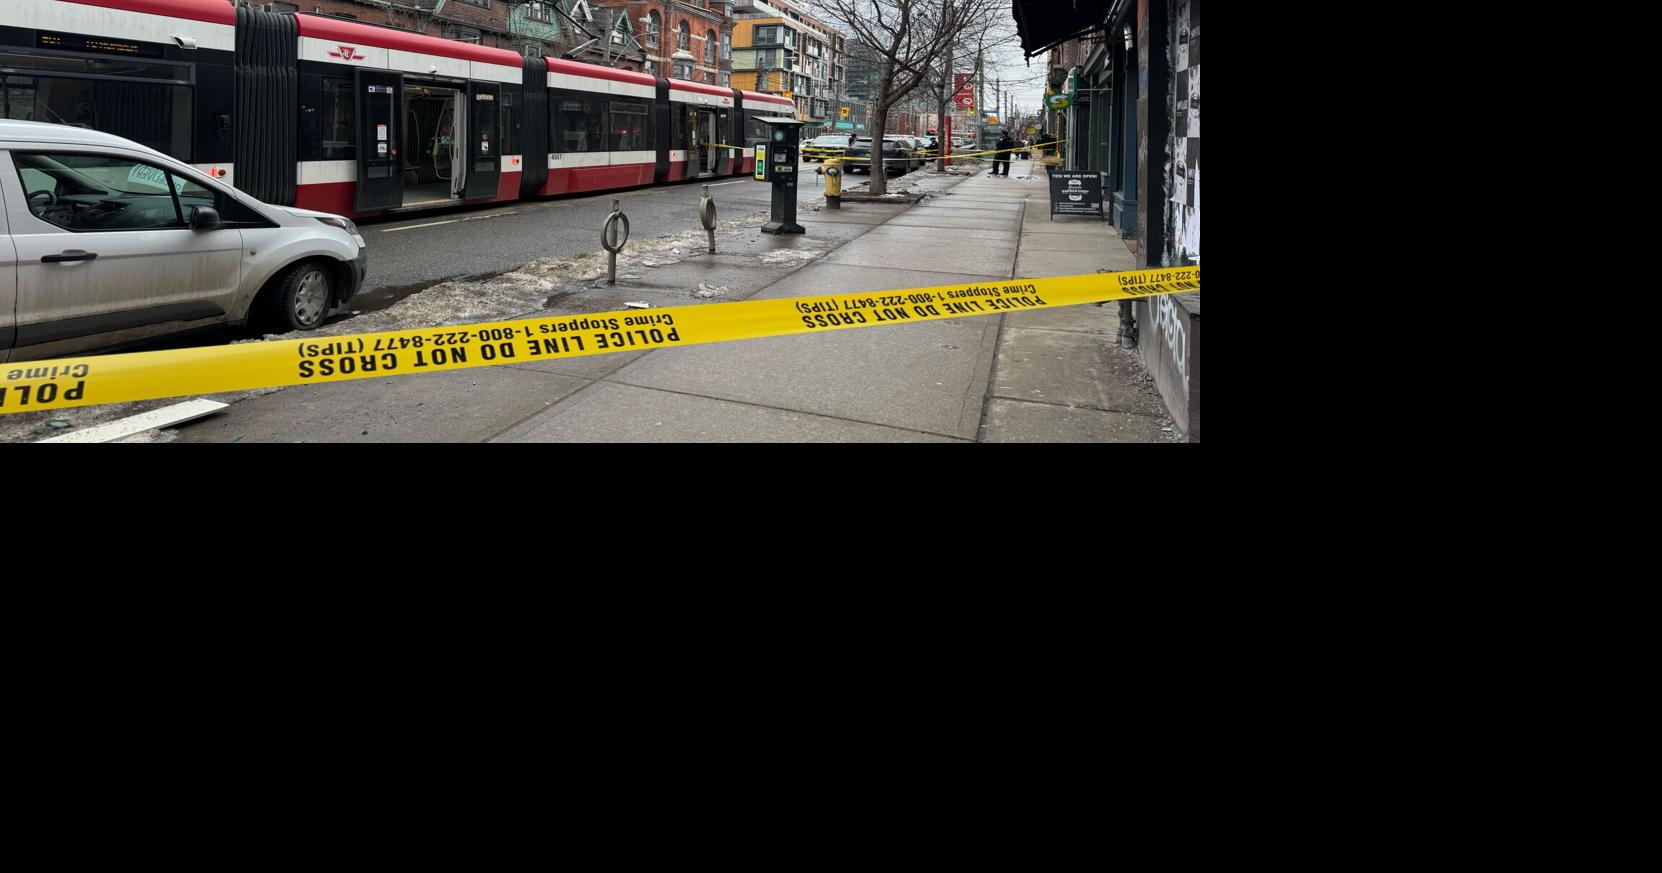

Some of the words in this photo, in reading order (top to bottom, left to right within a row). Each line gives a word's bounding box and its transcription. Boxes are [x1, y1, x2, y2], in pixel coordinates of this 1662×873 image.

[1118, 273, 1147, 286] (TIPS)
[947, 286, 1000, 299] Stoppers
[1003, 284, 1037, 294] Crime
[1123, 284, 1169, 296] CROSS
[796, 299, 839, 314] (TIPS)
[844, 291, 945, 310] 1-800-222-8477
[943, 301, 985, 314] LINE
[986, 295, 1047, 310] POLICE
[874, 307, 910, 322] NOT
[914, 304, 941, 317] DO
[541, 317, 620, 334] Stoppers
[624, 313, 674, 327] Crime
[802, 311, 867, 329] CROSS
[374, 325, 534, 352] 1-800-222-8477
[529, 335, 585, 356] LINE
[594, 327, 680, 349] POLICE
[298, 337, 364, 358] (TIPS)
[480, 342, 516, 361] DO
[298, 352, 398, 379] CROSS
[413, 347, 468, 368] NOT
[7, 363, 89, 380] Crime
[0, 380, 85, 408] POLI
